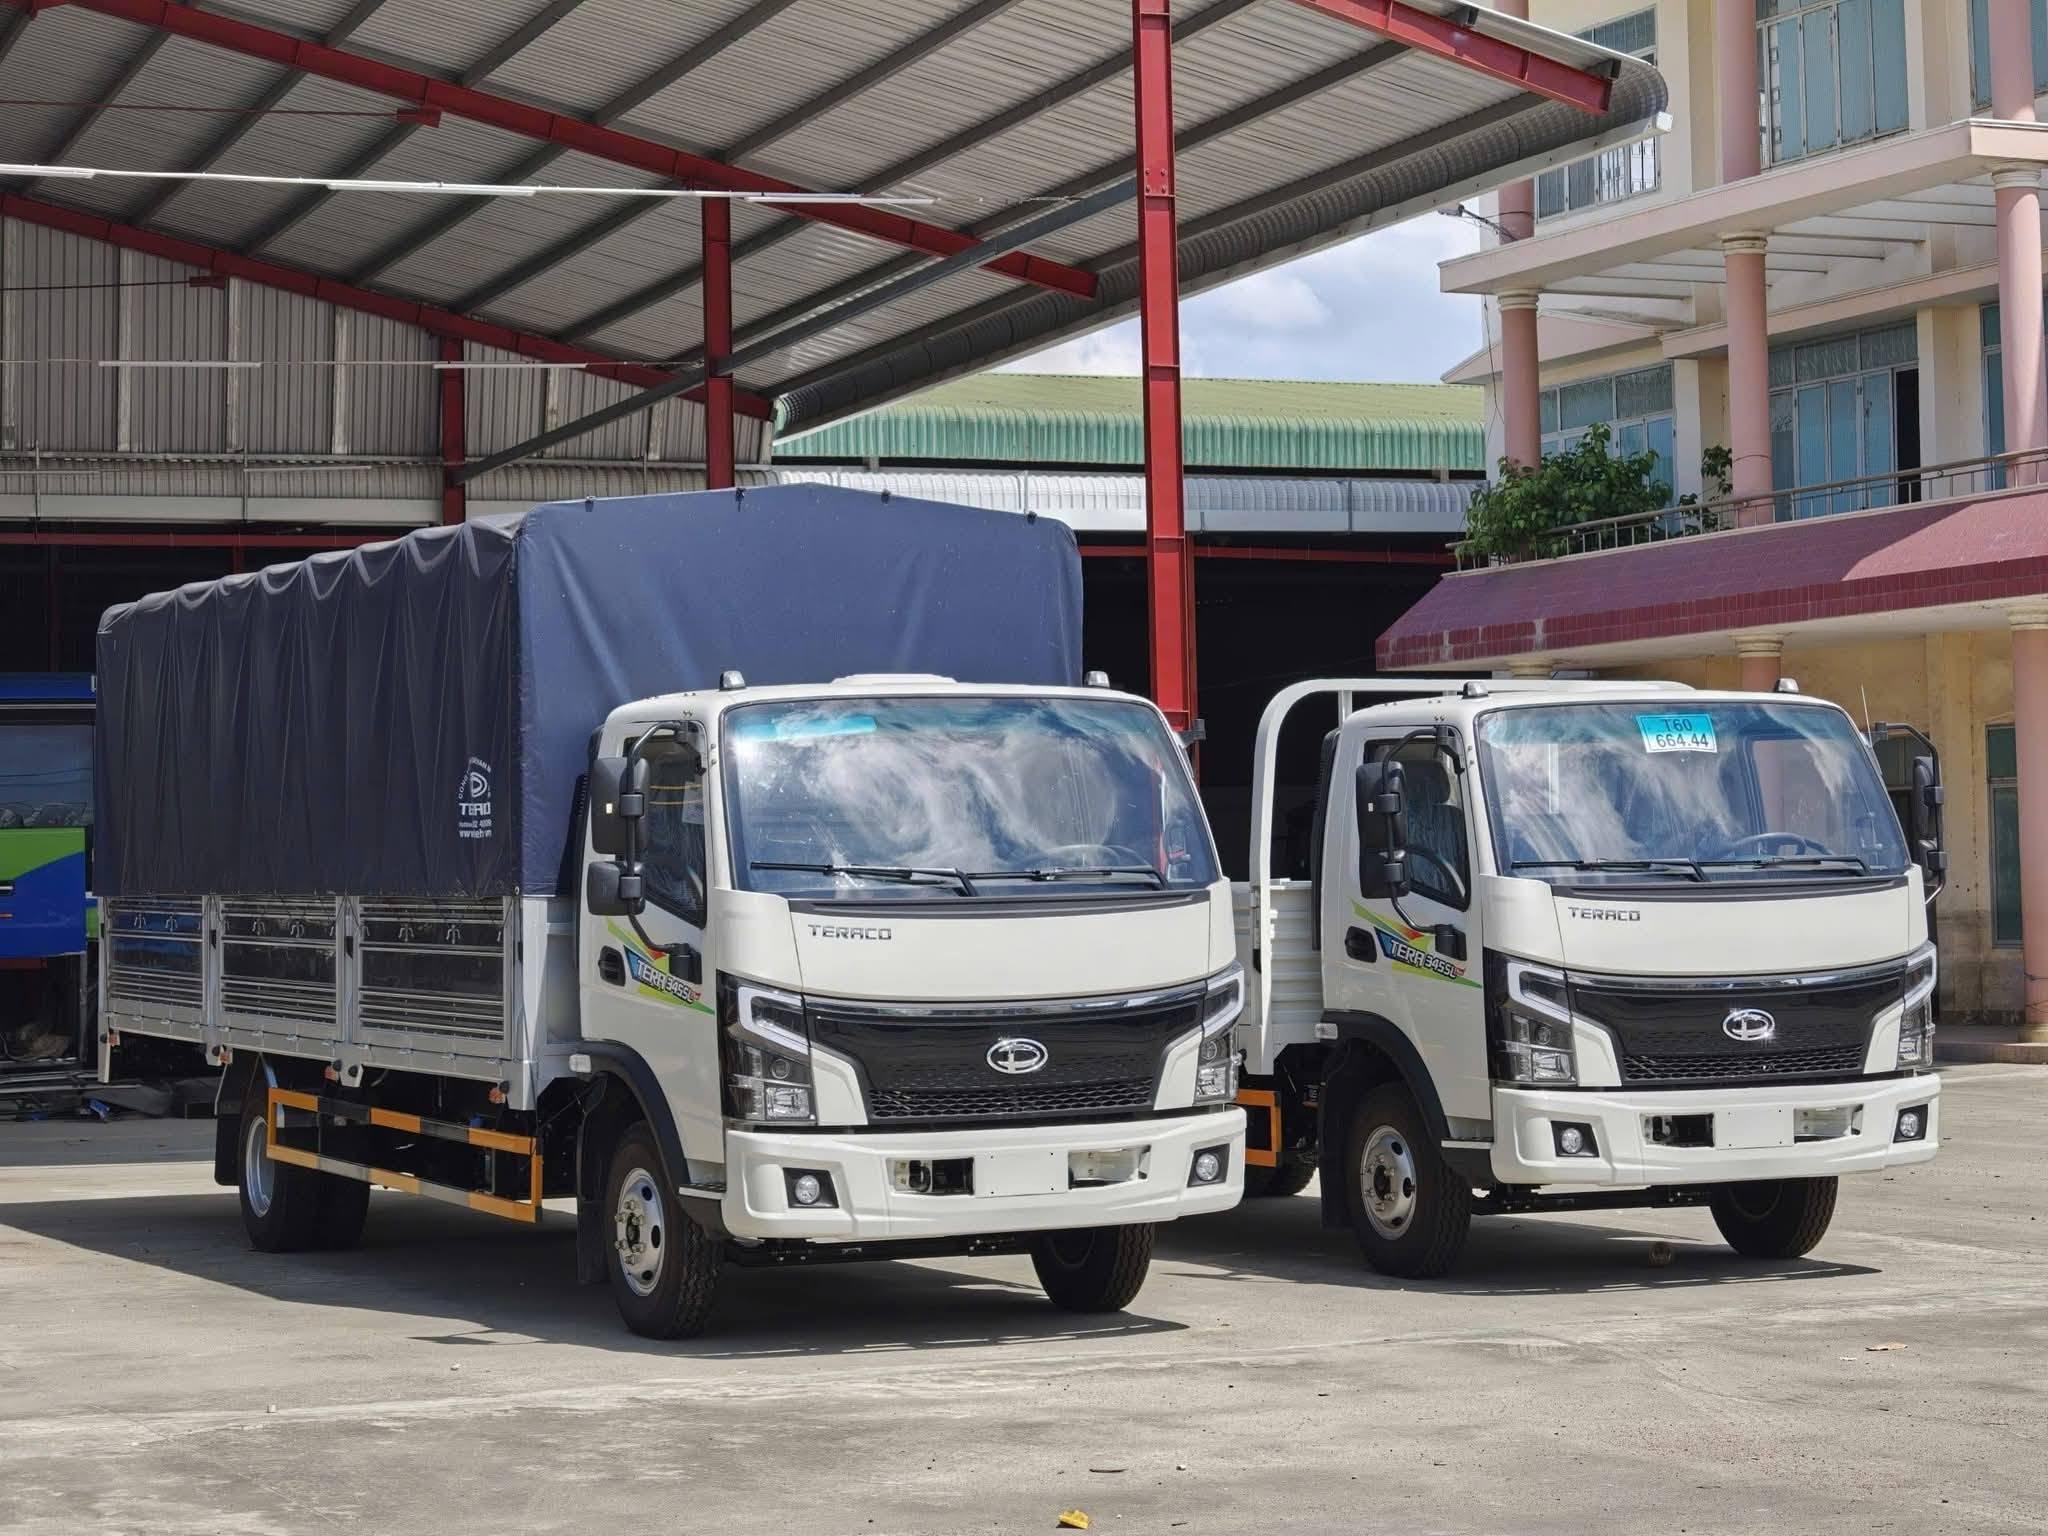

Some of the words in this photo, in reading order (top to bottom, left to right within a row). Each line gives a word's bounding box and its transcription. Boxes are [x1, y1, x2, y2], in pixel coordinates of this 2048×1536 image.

[1662, 718, 1693, 733] T60
[1655, 733, 1709, 749] 664.44
[1567, 906, 1641, 922] TERACO
[807, 924, 892, 941] TERACO
[1391, 940, 1426, 968] TERA
[637, 959, 666, 991] TERA
